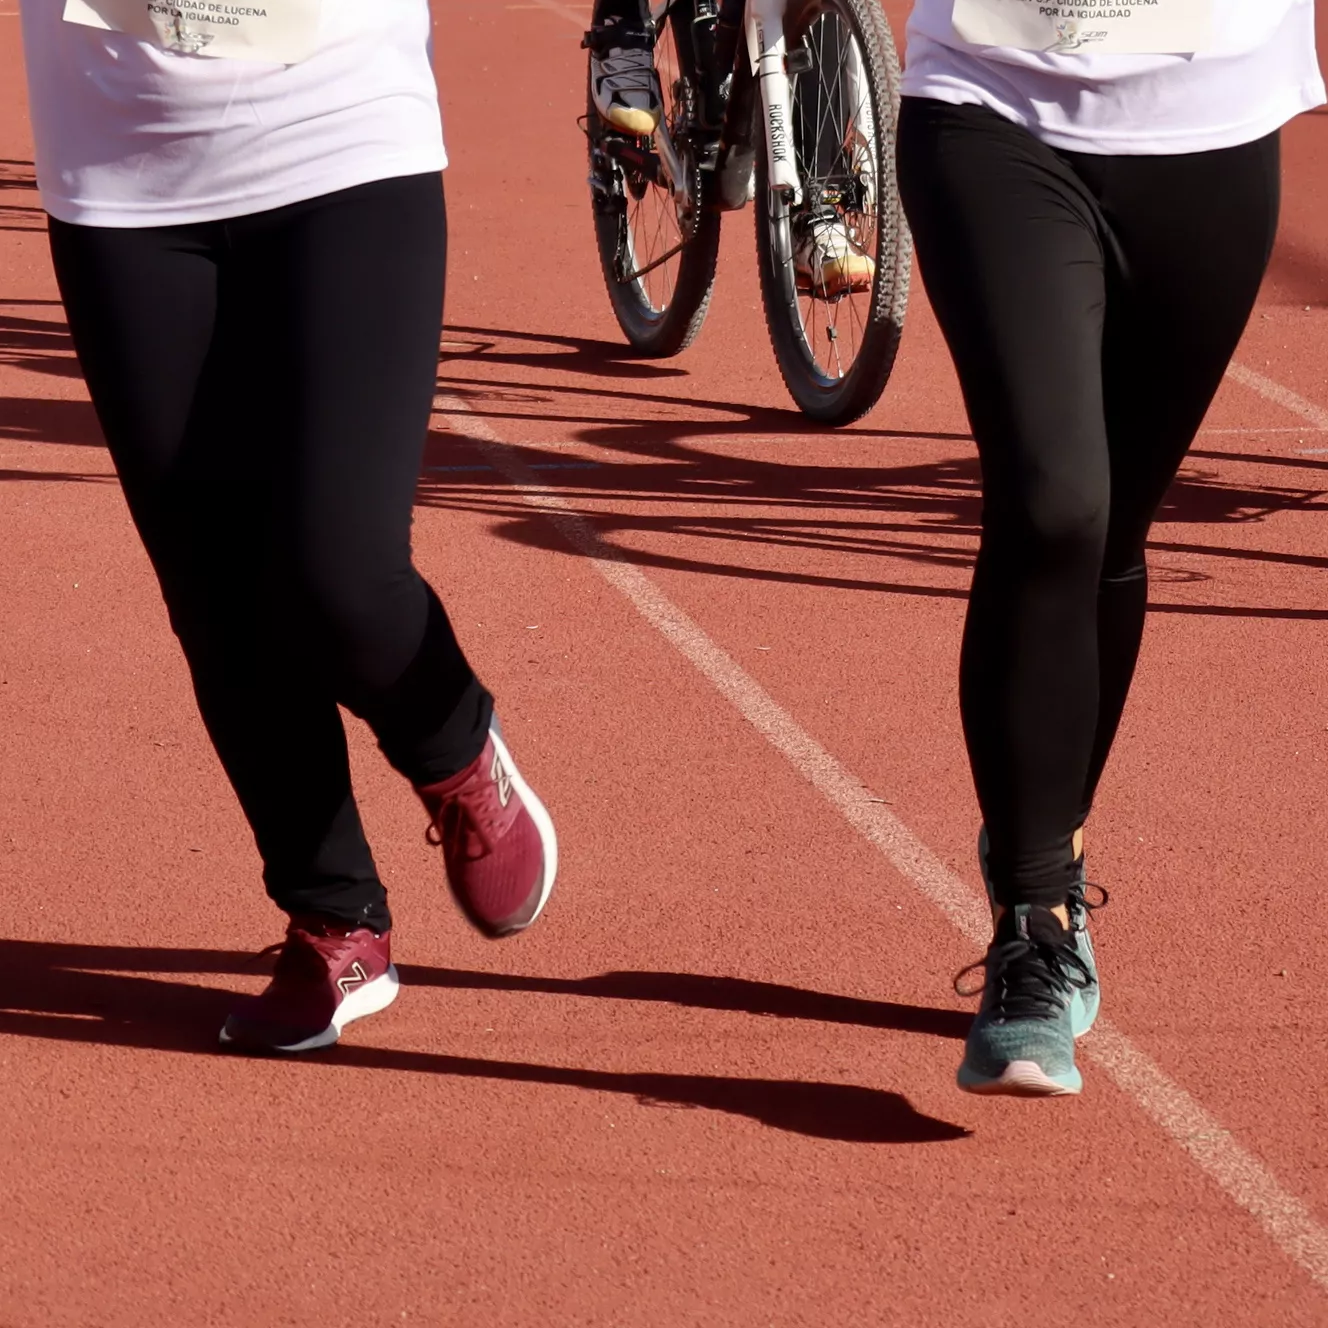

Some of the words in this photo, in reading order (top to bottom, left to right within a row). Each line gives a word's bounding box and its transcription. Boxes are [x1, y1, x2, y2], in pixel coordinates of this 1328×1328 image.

[147, 4, 168, 15] POR
[170, 7, 183, 19] LA
[185, 12, 240, 26] IGUALDAD
[208, 4, 222, 13] DE
[224, 5, 268, 17] LUCENA
[1039, 6, 1059, 17] POR
[1061, 8, 1075, 18] LA
[1077, 9, 1132, 19] IGUALDAD
